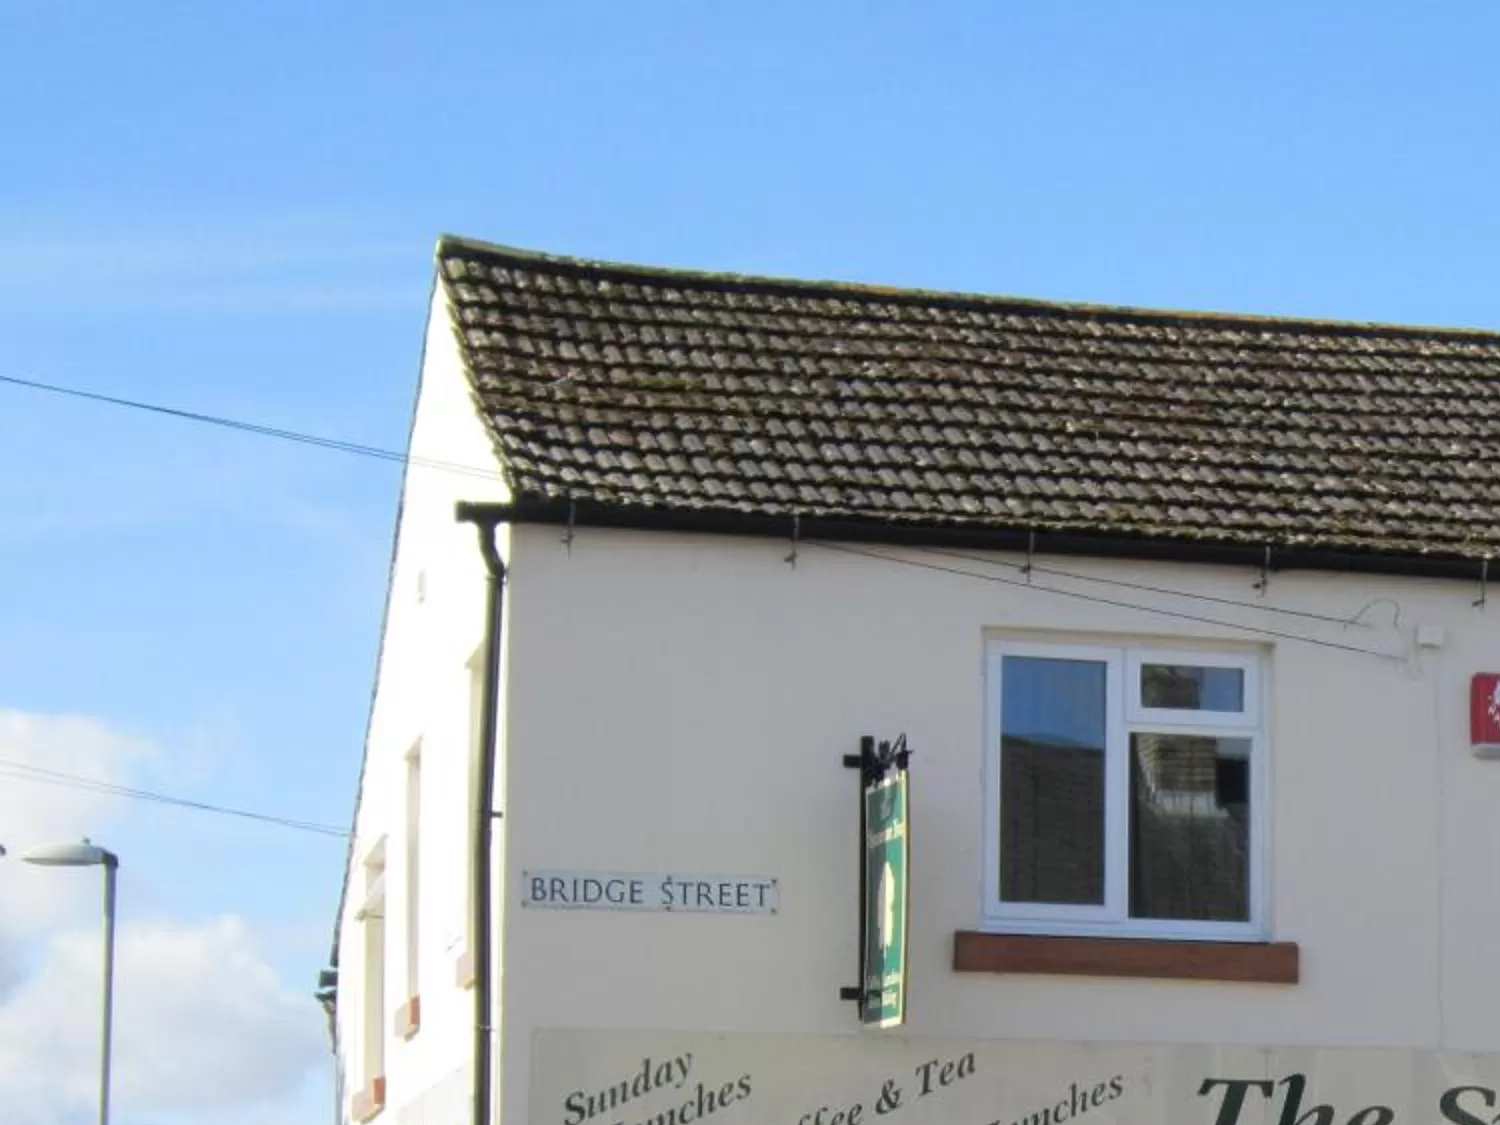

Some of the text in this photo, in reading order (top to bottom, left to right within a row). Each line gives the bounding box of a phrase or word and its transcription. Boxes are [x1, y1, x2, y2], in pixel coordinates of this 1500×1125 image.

[529, 875, 773, 909] BRIDGE STREET
[873, 1078, 904, 1117] &
[915, 1051, 977, 1098] Tea
